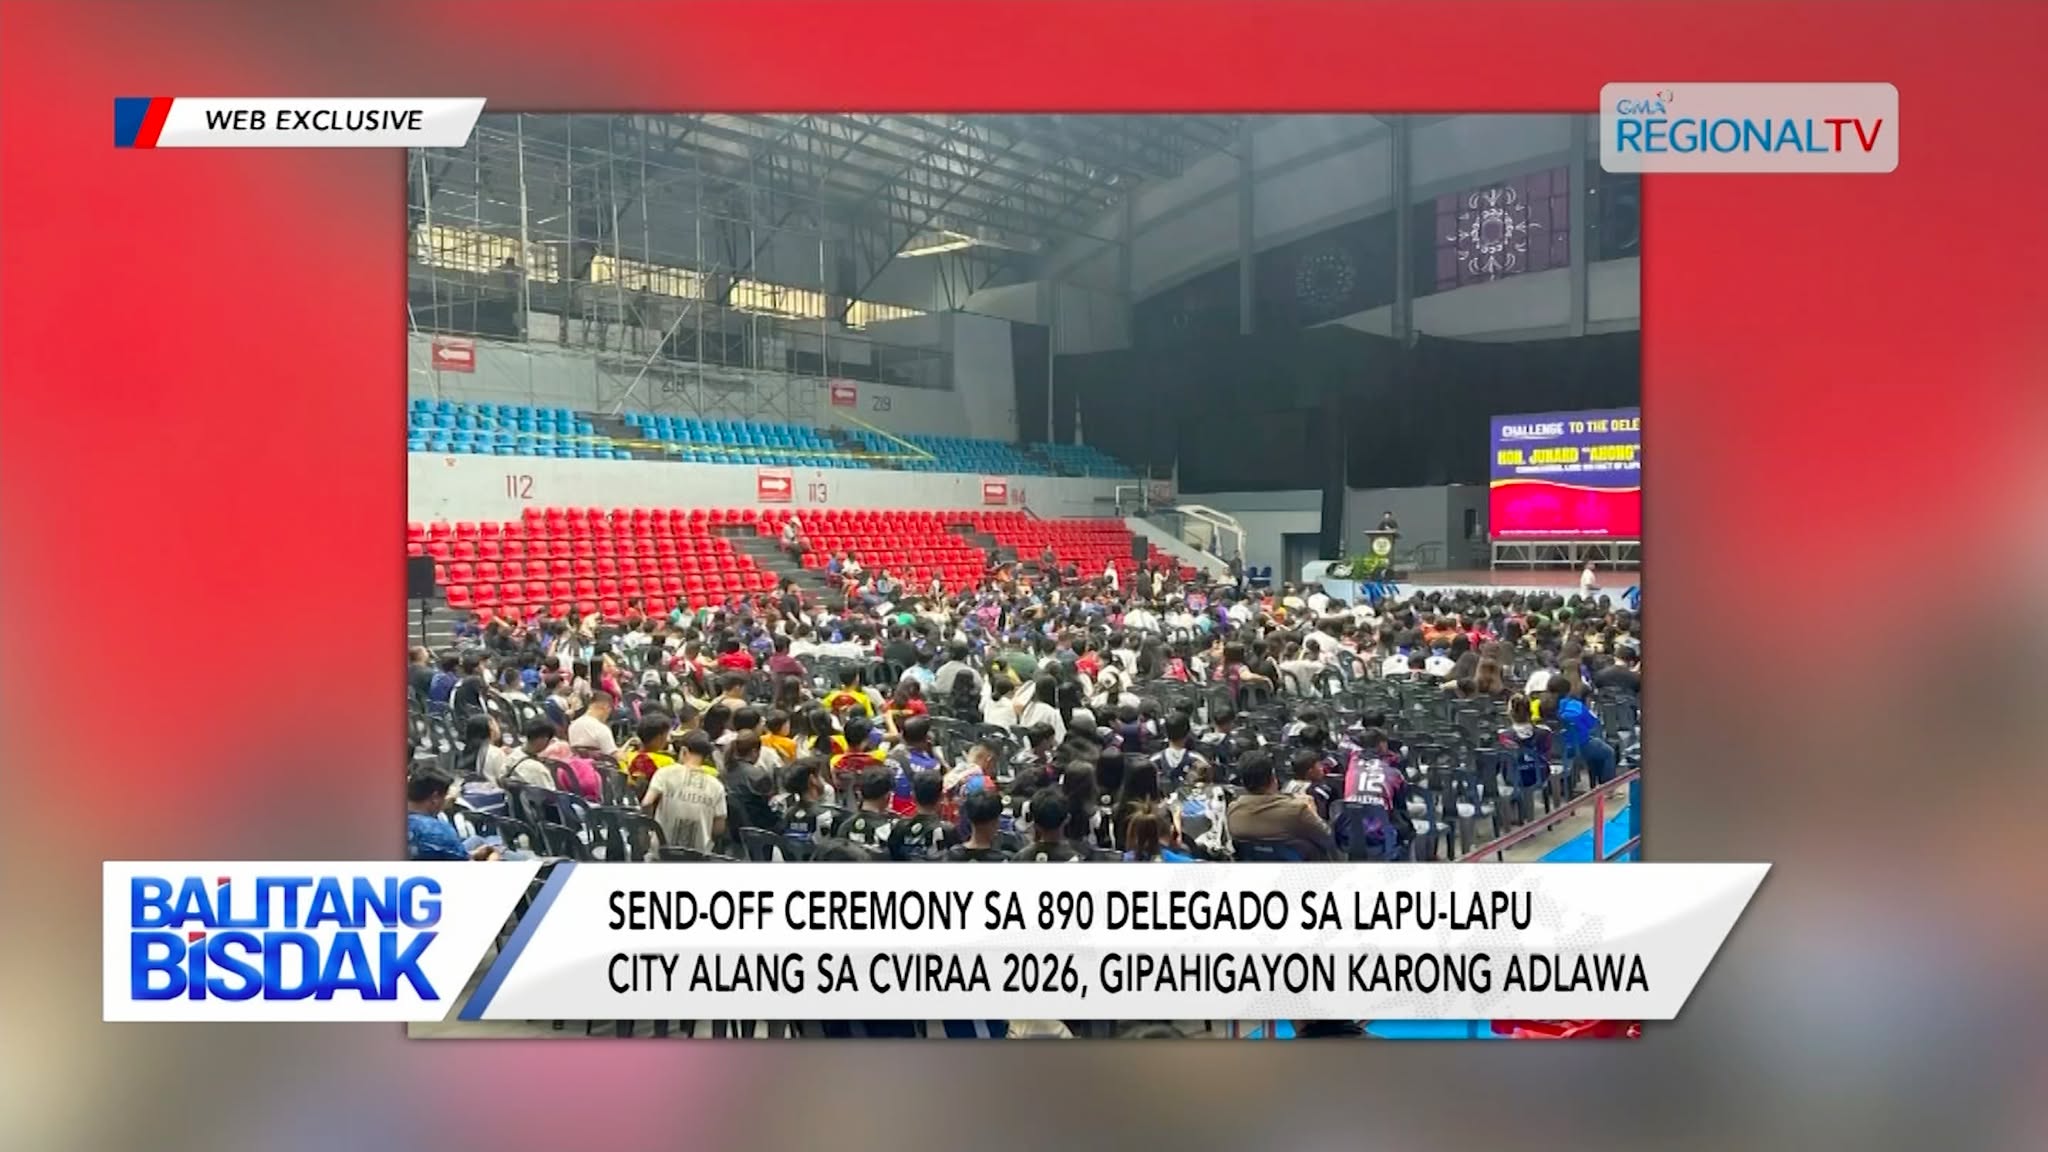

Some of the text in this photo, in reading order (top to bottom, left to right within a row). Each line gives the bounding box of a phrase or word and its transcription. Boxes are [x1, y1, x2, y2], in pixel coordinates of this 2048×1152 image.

[1502, 422, 1564, 437] CHALLENGE
[1569, 421, 1584, 433] TO
[1587, 419, 1608, 433] THE
[505, 475, 534, 499] 112
[808, 483, 828, 503] 113
[1358, 771, 1386, 794] 12
